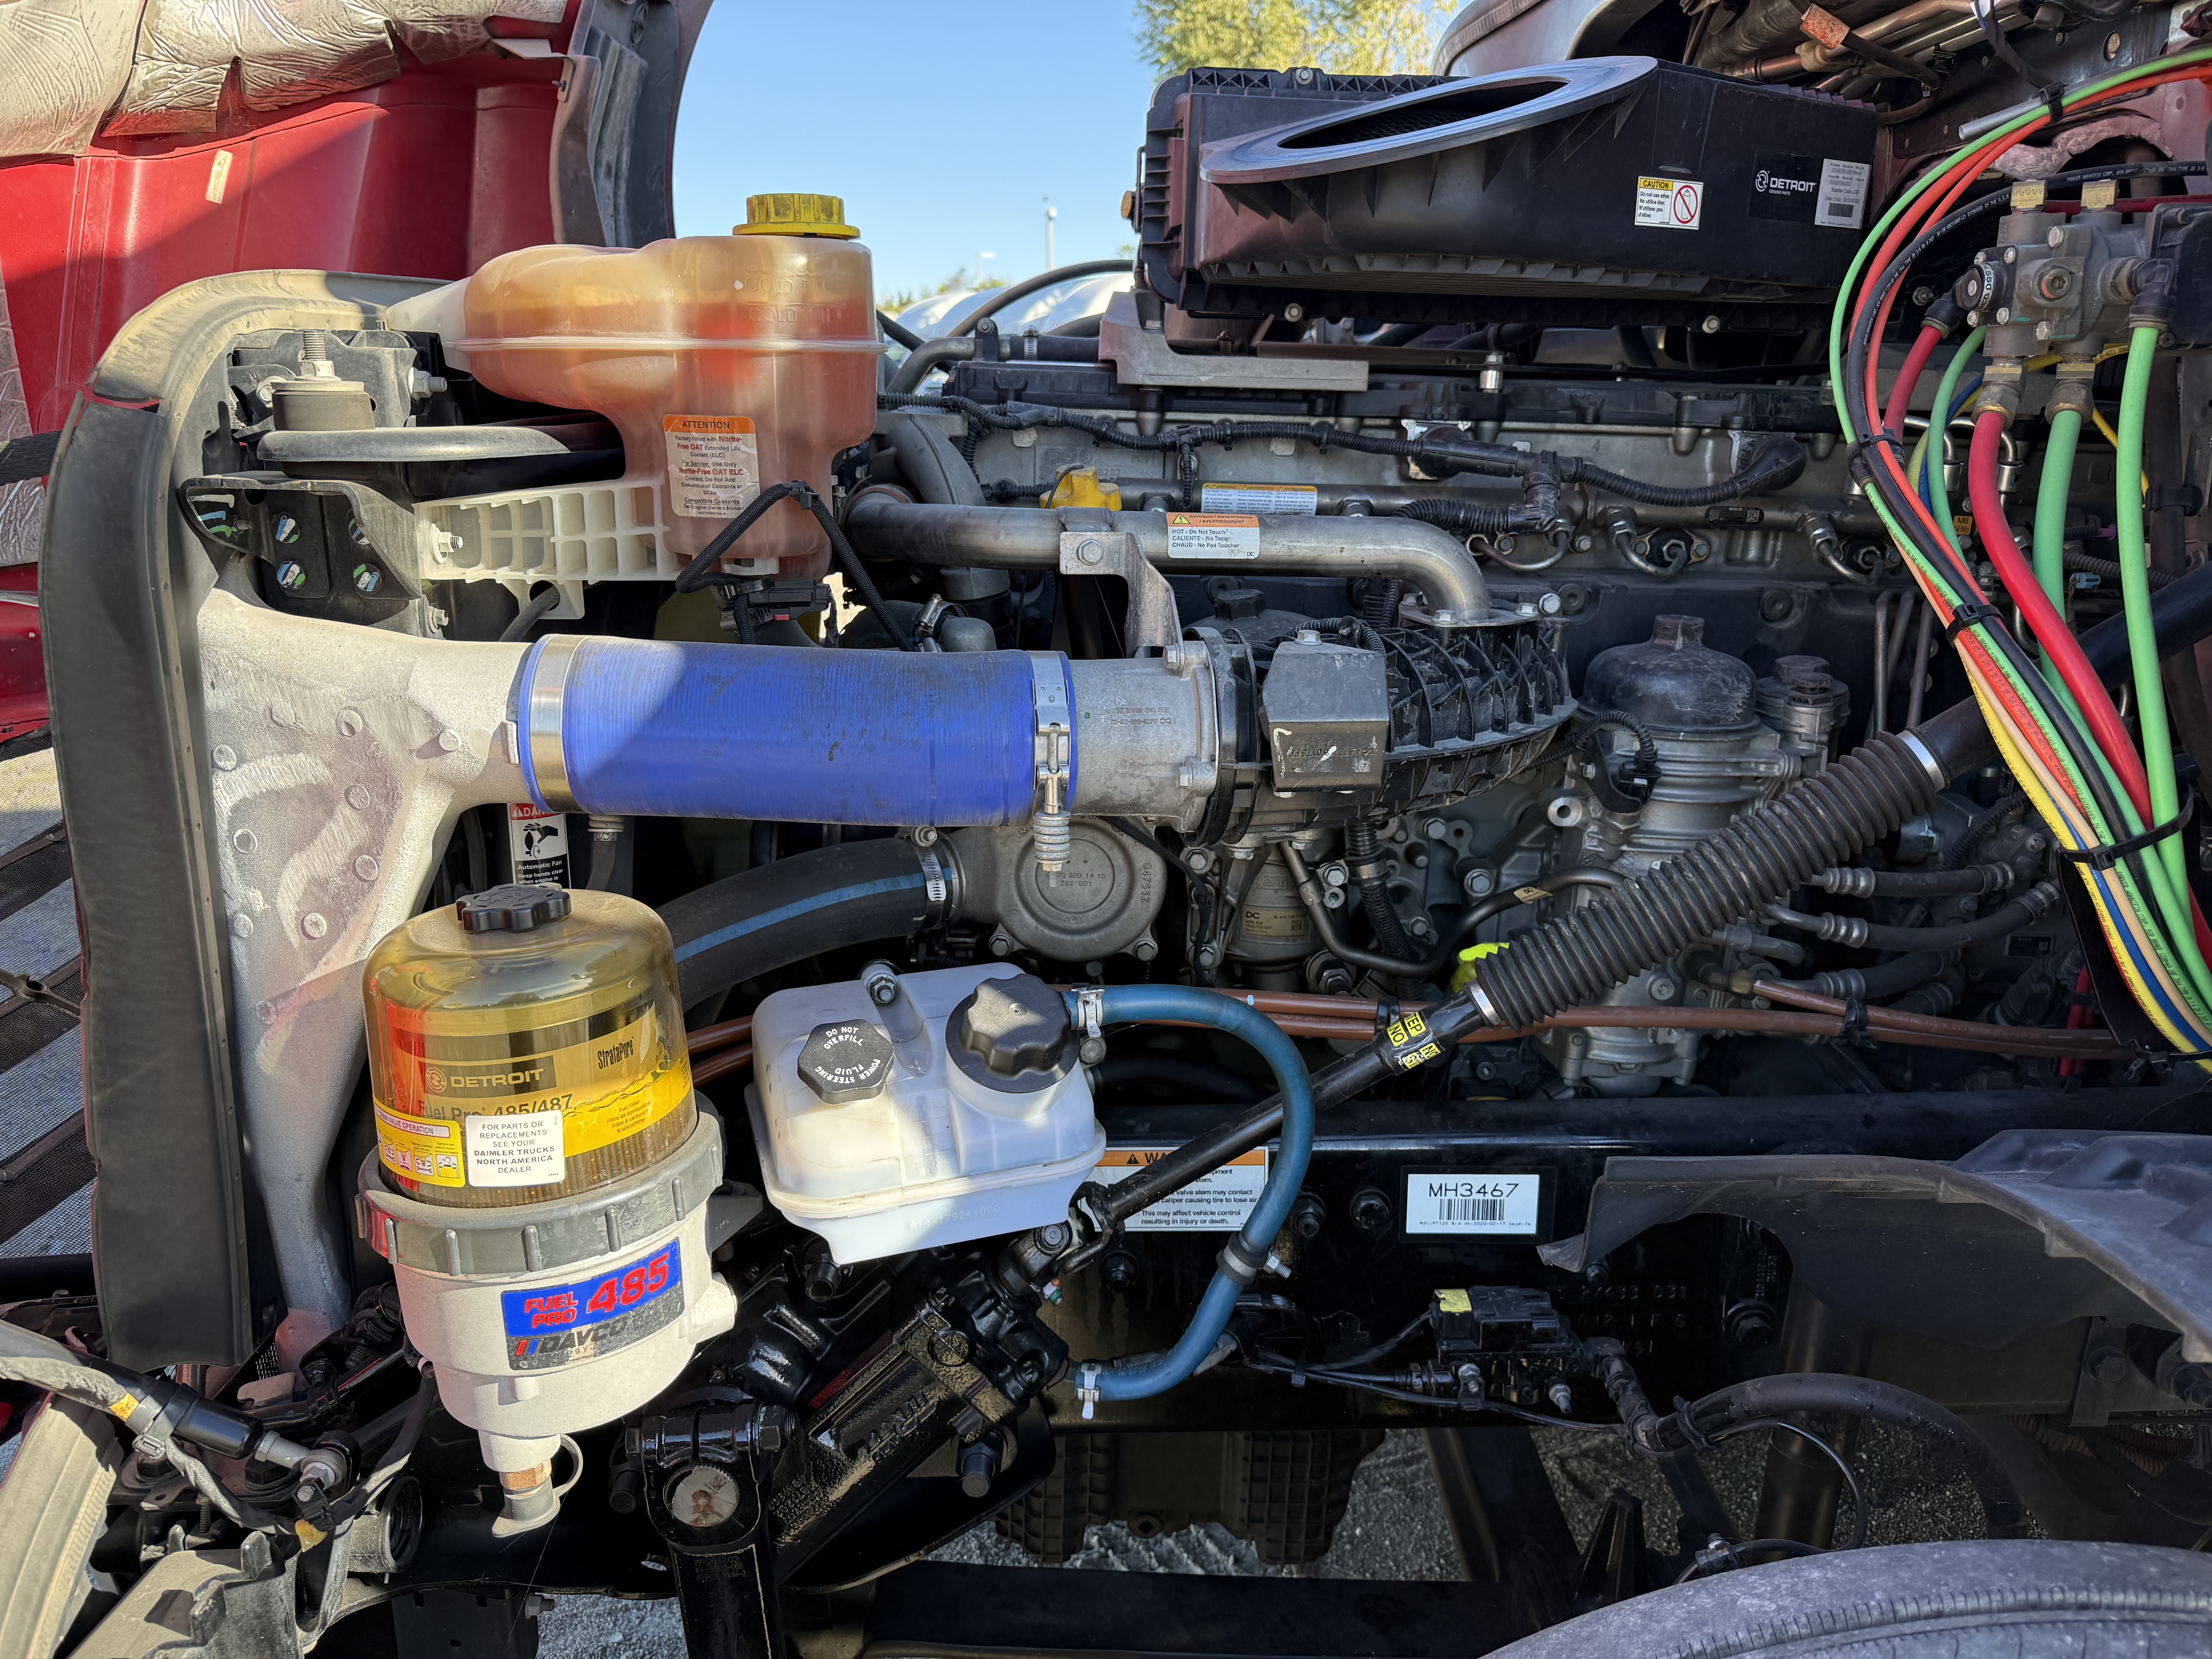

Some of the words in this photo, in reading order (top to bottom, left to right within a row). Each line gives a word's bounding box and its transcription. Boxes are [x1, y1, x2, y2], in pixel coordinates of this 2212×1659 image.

[1644, 180, 1669, 189] CAUTION
[1770, 177, 1815, 192] DETROIT
[746, 277, 793, 294] COLD
[750, 307, 797, 322] COLD
[683, 421, 730, 429] ATTENTION
[1973, 646, 1985, 658] 01/20
[1980, 637, 1991, 651] BRAKE
[2020, 692, 2029, 704] TYPE
[1982, 658, 1992, 668] DOT
[2007, 695, 2017, 708] TYPE
[2080, 796, 2095, 821] EXTRUDED
[1141, 862, 1152, 902] 047532
[2117, 871, 2129, 888] PARKER
[826, 1029, 838, 1037] DO
[1389, 1025, 1405, 1042] NO
[824, 1034, 863, 1049] OVERFILL
[598, 1039, 634, 1069] StrataPore
[815, 1066, 855, 1083] STEERING
[835, 1064, 864, 1075] FLUID
[859, 1059, 881, 1080] POWER
[450, 1068, 544, 1087] DETROIT
[419, 1100, 446, 1120] Fuel
[630, 1100, 640, 1108] Filter
[629, 1109, 648, 1121] carburant
[389, 1116, 401, 1127] VALVE
[403, 1121, 433, 1134] OPERATION
[480, 1130, 547, 1139] REPLACEMENTS
[518, 1146, 555, 1155] TRUCKS
[511, 1155, 553, 1163] AMERICA
[1429, 1183, 1519, 1197] MH3467
[524, 1291, 578, 1313] FUEL
[586, 1252, 670, 1314] 485
[532, 1307, 577, 1329] PRO
[539, 1316, 628, 1353] DAVCO
